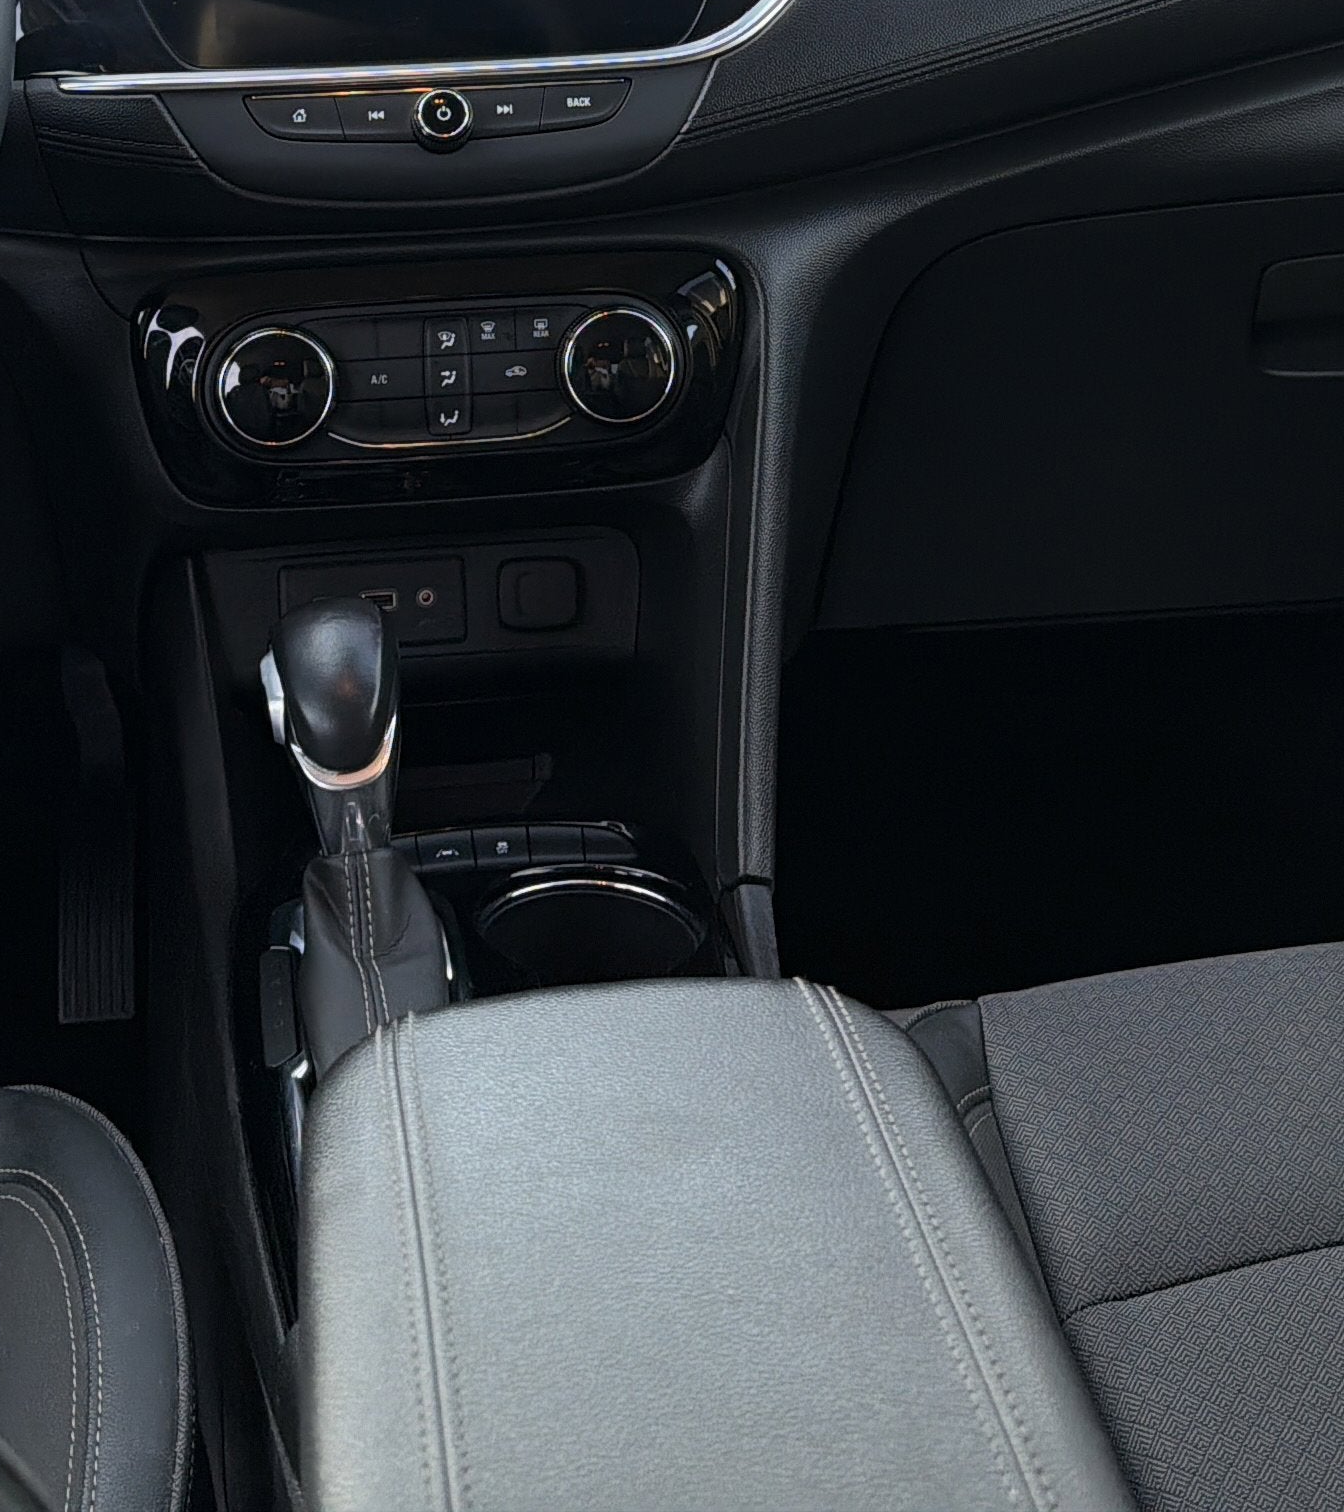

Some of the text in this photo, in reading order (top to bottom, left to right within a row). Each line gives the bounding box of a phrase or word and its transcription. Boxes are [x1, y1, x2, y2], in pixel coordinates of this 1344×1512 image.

[566, 96, 591, 108] BACK
[481, 332, 496, 341] MAX
[532, 329, 550, 338] REAR
[370, 373, 388, 385] A/C
